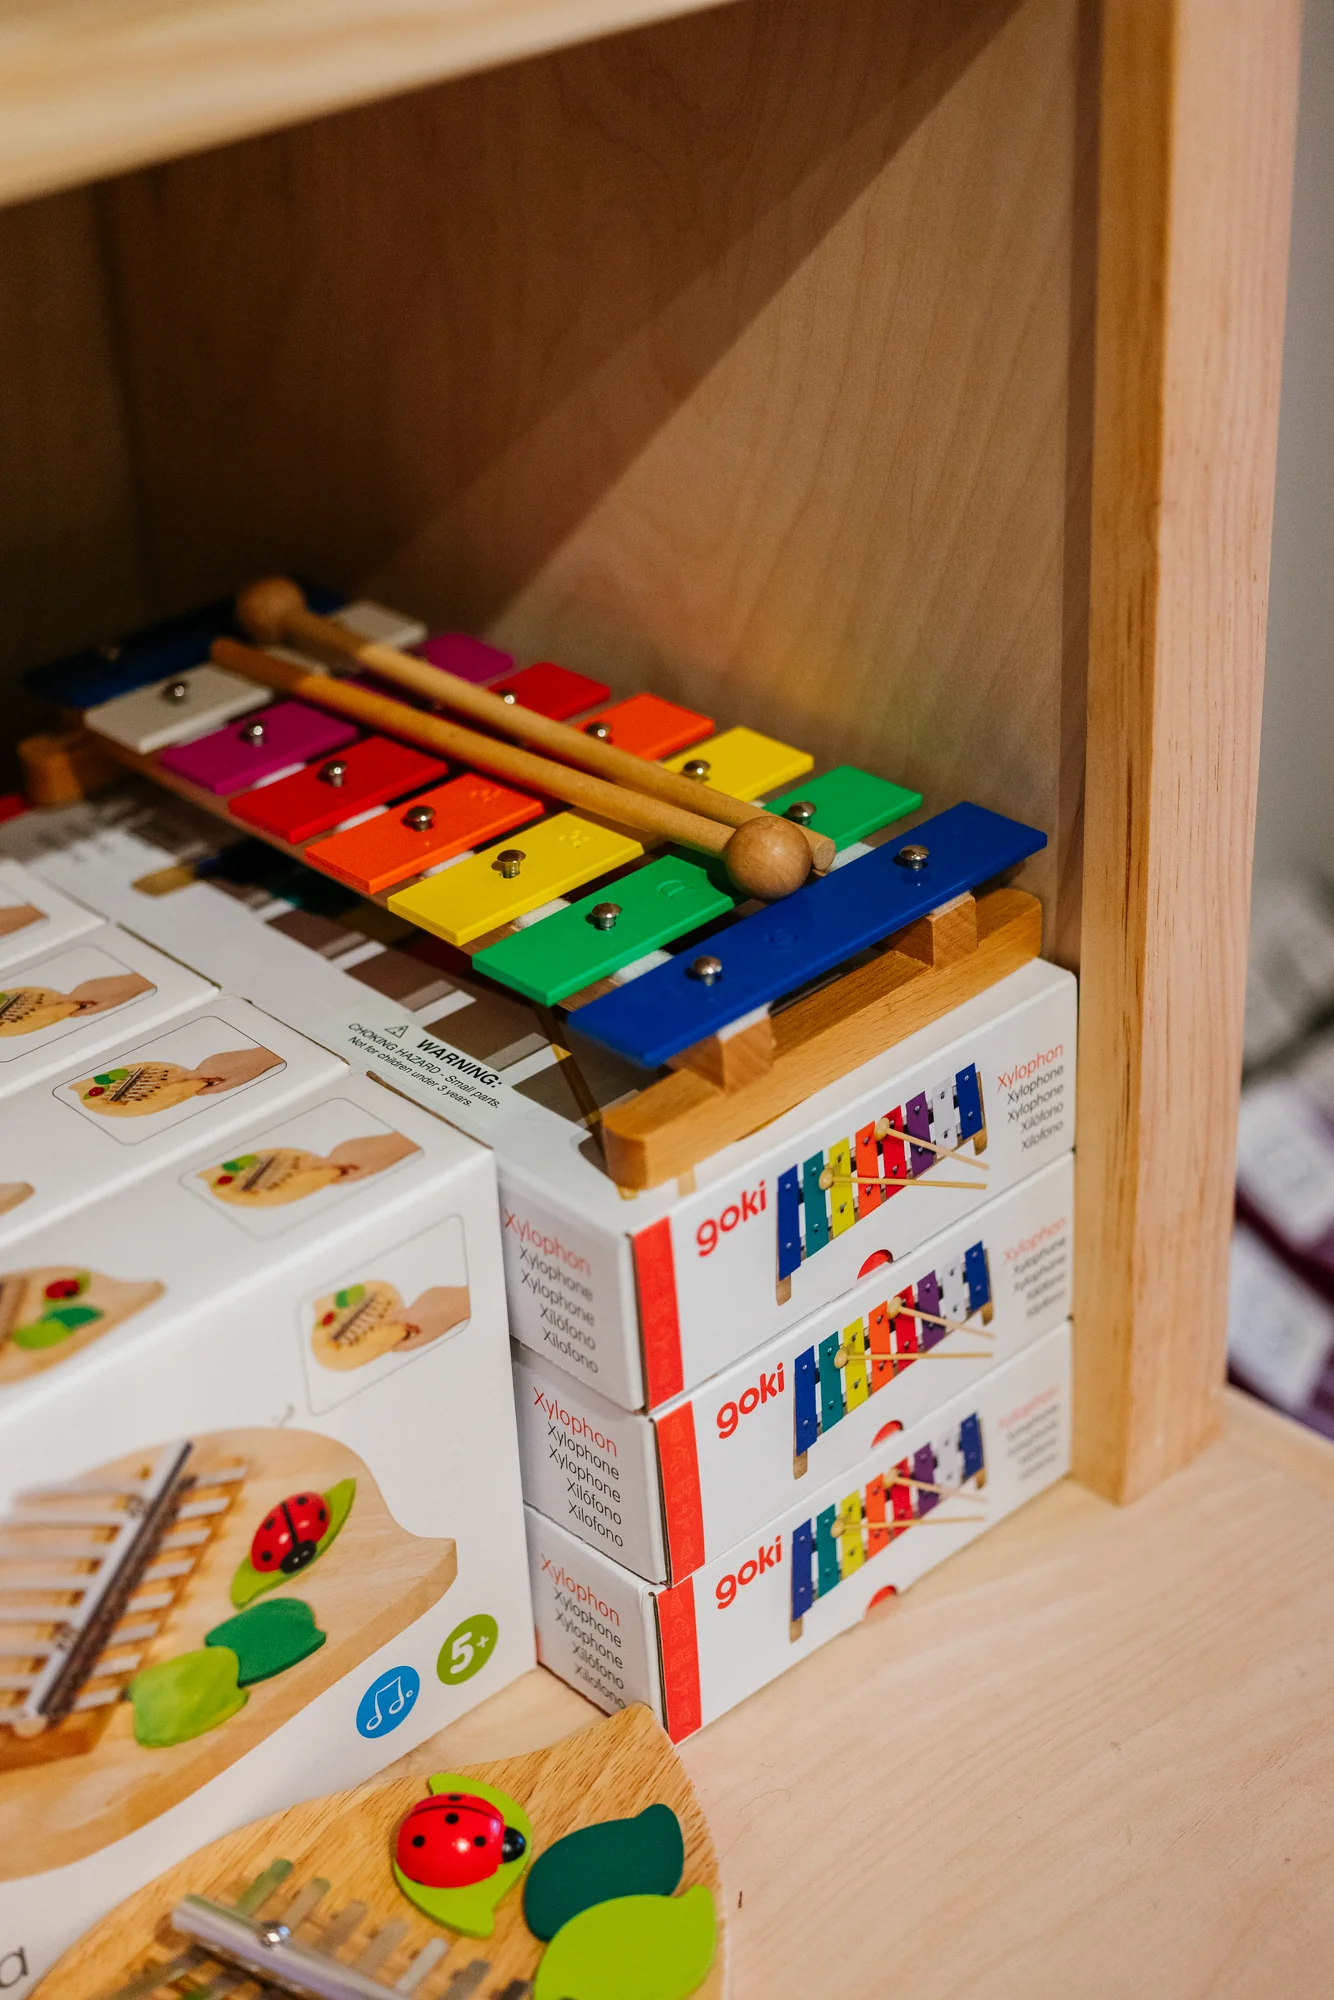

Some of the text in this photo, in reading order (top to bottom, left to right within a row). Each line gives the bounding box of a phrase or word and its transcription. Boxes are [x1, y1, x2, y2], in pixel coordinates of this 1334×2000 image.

[348, 1023, 398, 1050] CHOKING
[395, 1048, 441, 1075] HAZARD
[445, 1075, 474, 1093] Small
[471, 1089, 501, 1108] parts.
[348, 1036, 364, 1049] Not
[365, 1044, 381, 1055] for
[377, 1051, 413, 1074] children
[411, 1072, 439, 1087] under
[443, 1090, 472, 1107] years.
[416, 1039, 502, 1088] WARNING:
[997, 1044, 1063, 1092] Xylophon
[1007, 1066, 1064, 1105] Xylophone
[1007, 1084, 1064, 1123] Xylophone
[504, 1208, 591, 1276] Xylophon
[696, 1180, 767, 1257] goki
[520, 1245, 594, 1302] Xylophone
[521, 1269, 595, 1327] Xylophone
[540, 1303, 596, 1350] Xilófono
[542, 1327, 599, 1374] Xilofono
[533, 1386, 617, 1457] Xylophon
[717, 1362, 785, 1439] goki
[548, 1422, 620, 1480] Xylophone
[549, 1444, 621, 1503] Xylophone
[566, 1477, 622, 1525] Xilófono
[568, 1500, 624, 1547] Xilofono
[541, 1553, 620, 1627] Xylophon
[715, 1535, 782, 1610] goki
[554, 1587, 622, 1648] Xylophone
[555, 1609, 624, 1669] Xylophone
[449, 1631, 490, 1675] 5+
